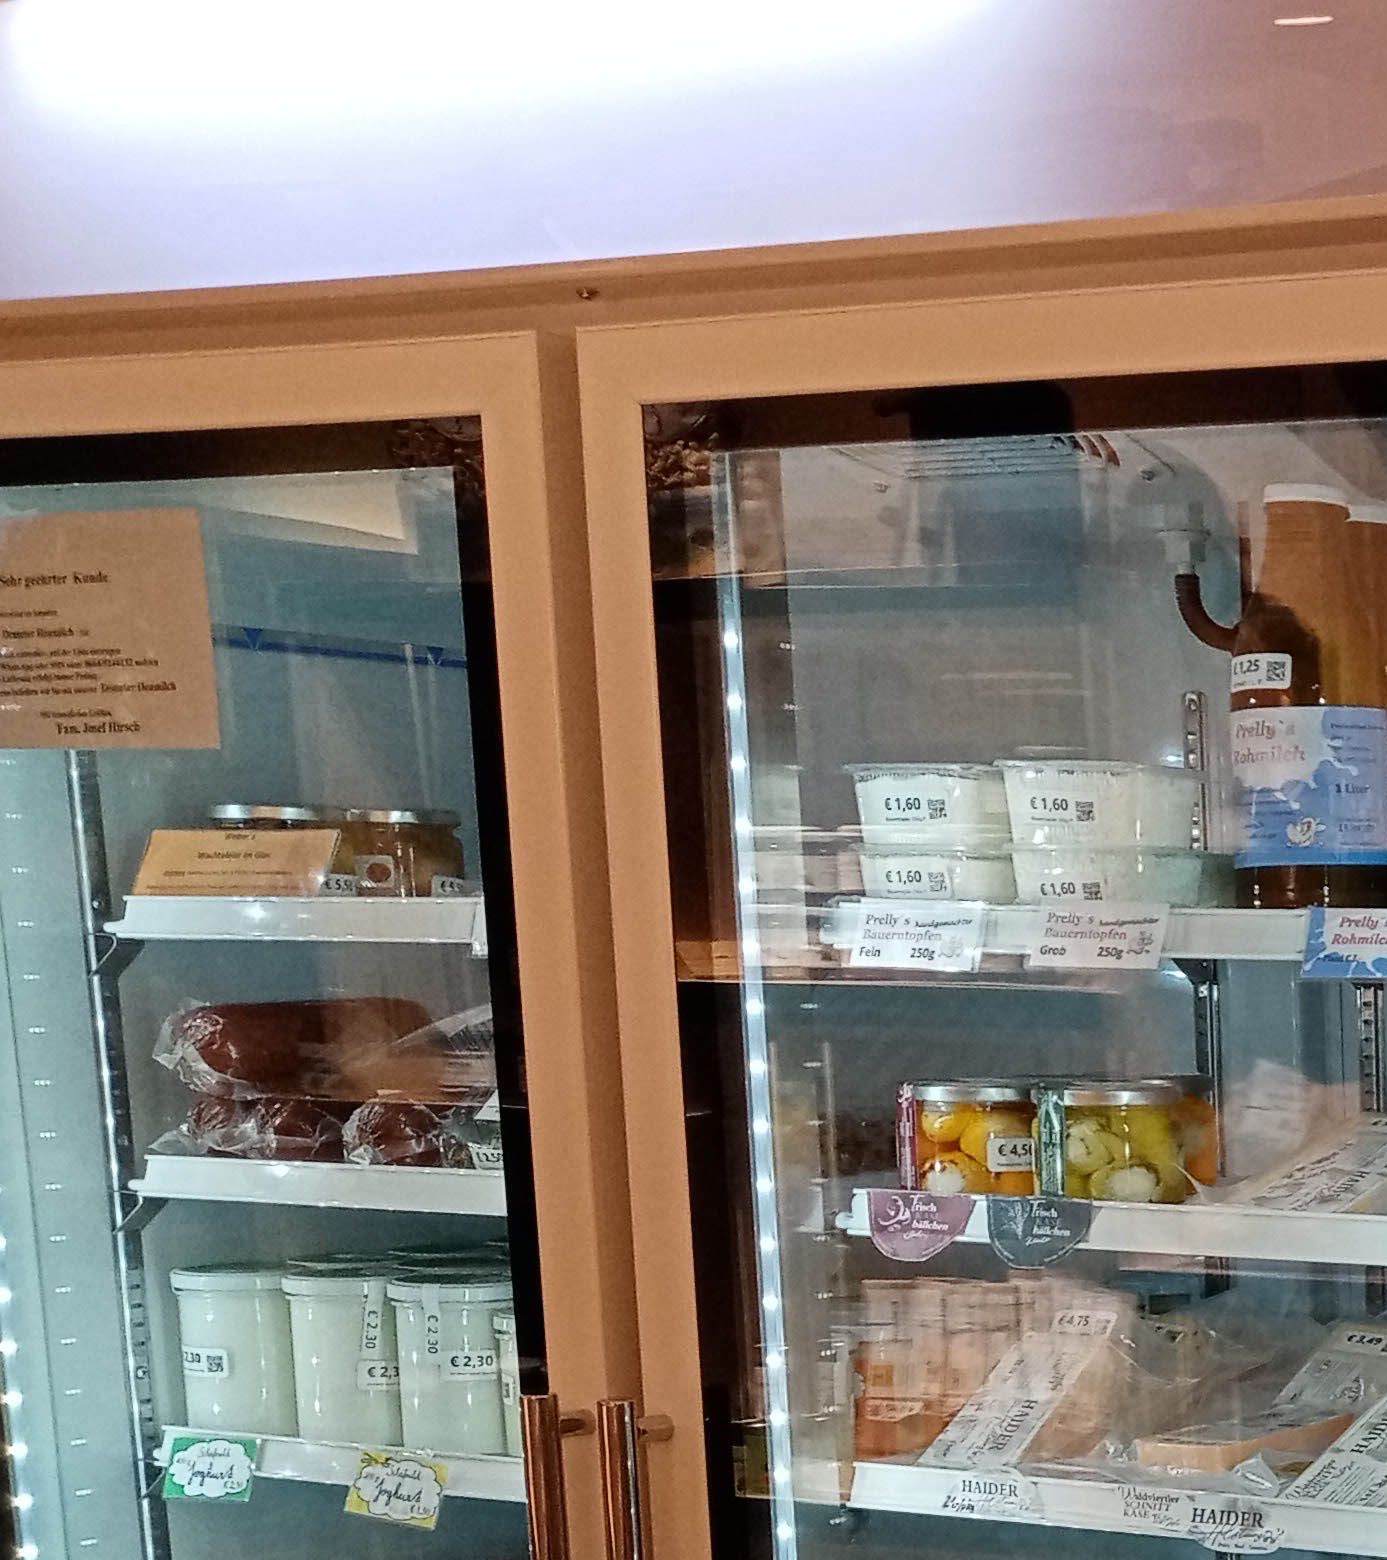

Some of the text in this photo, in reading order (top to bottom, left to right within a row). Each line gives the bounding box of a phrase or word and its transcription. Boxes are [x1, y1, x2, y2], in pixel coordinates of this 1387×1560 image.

[895, 798, 921, 814] 1,60
[1040, 798, 1069, 814] 1,60
[895, 870, 922, 885] 1,60
[1050, 882, 1076, 898] 1,60
[862, 928, 943, 943] Bauerntopfen
[1043, 927, 1127, 942] Bauerntopfen
[858, 945, 936, 961] Fein 250g
[1039, 944, 1124, 960] Grob 250g
[909, 1195, 937, 1213] Frisch
[1030, 1199, 1058, 1218] Frisch
[911, 1219, 949, 1231] bällchen
[1032, 1226, 1071, 1237] bällchen
[463, 1355, 495, 1370] 2,30
[961, 1479, 1020, 1498] HAIDER
[1190, 1507, 1265, 1528] HAIDER
